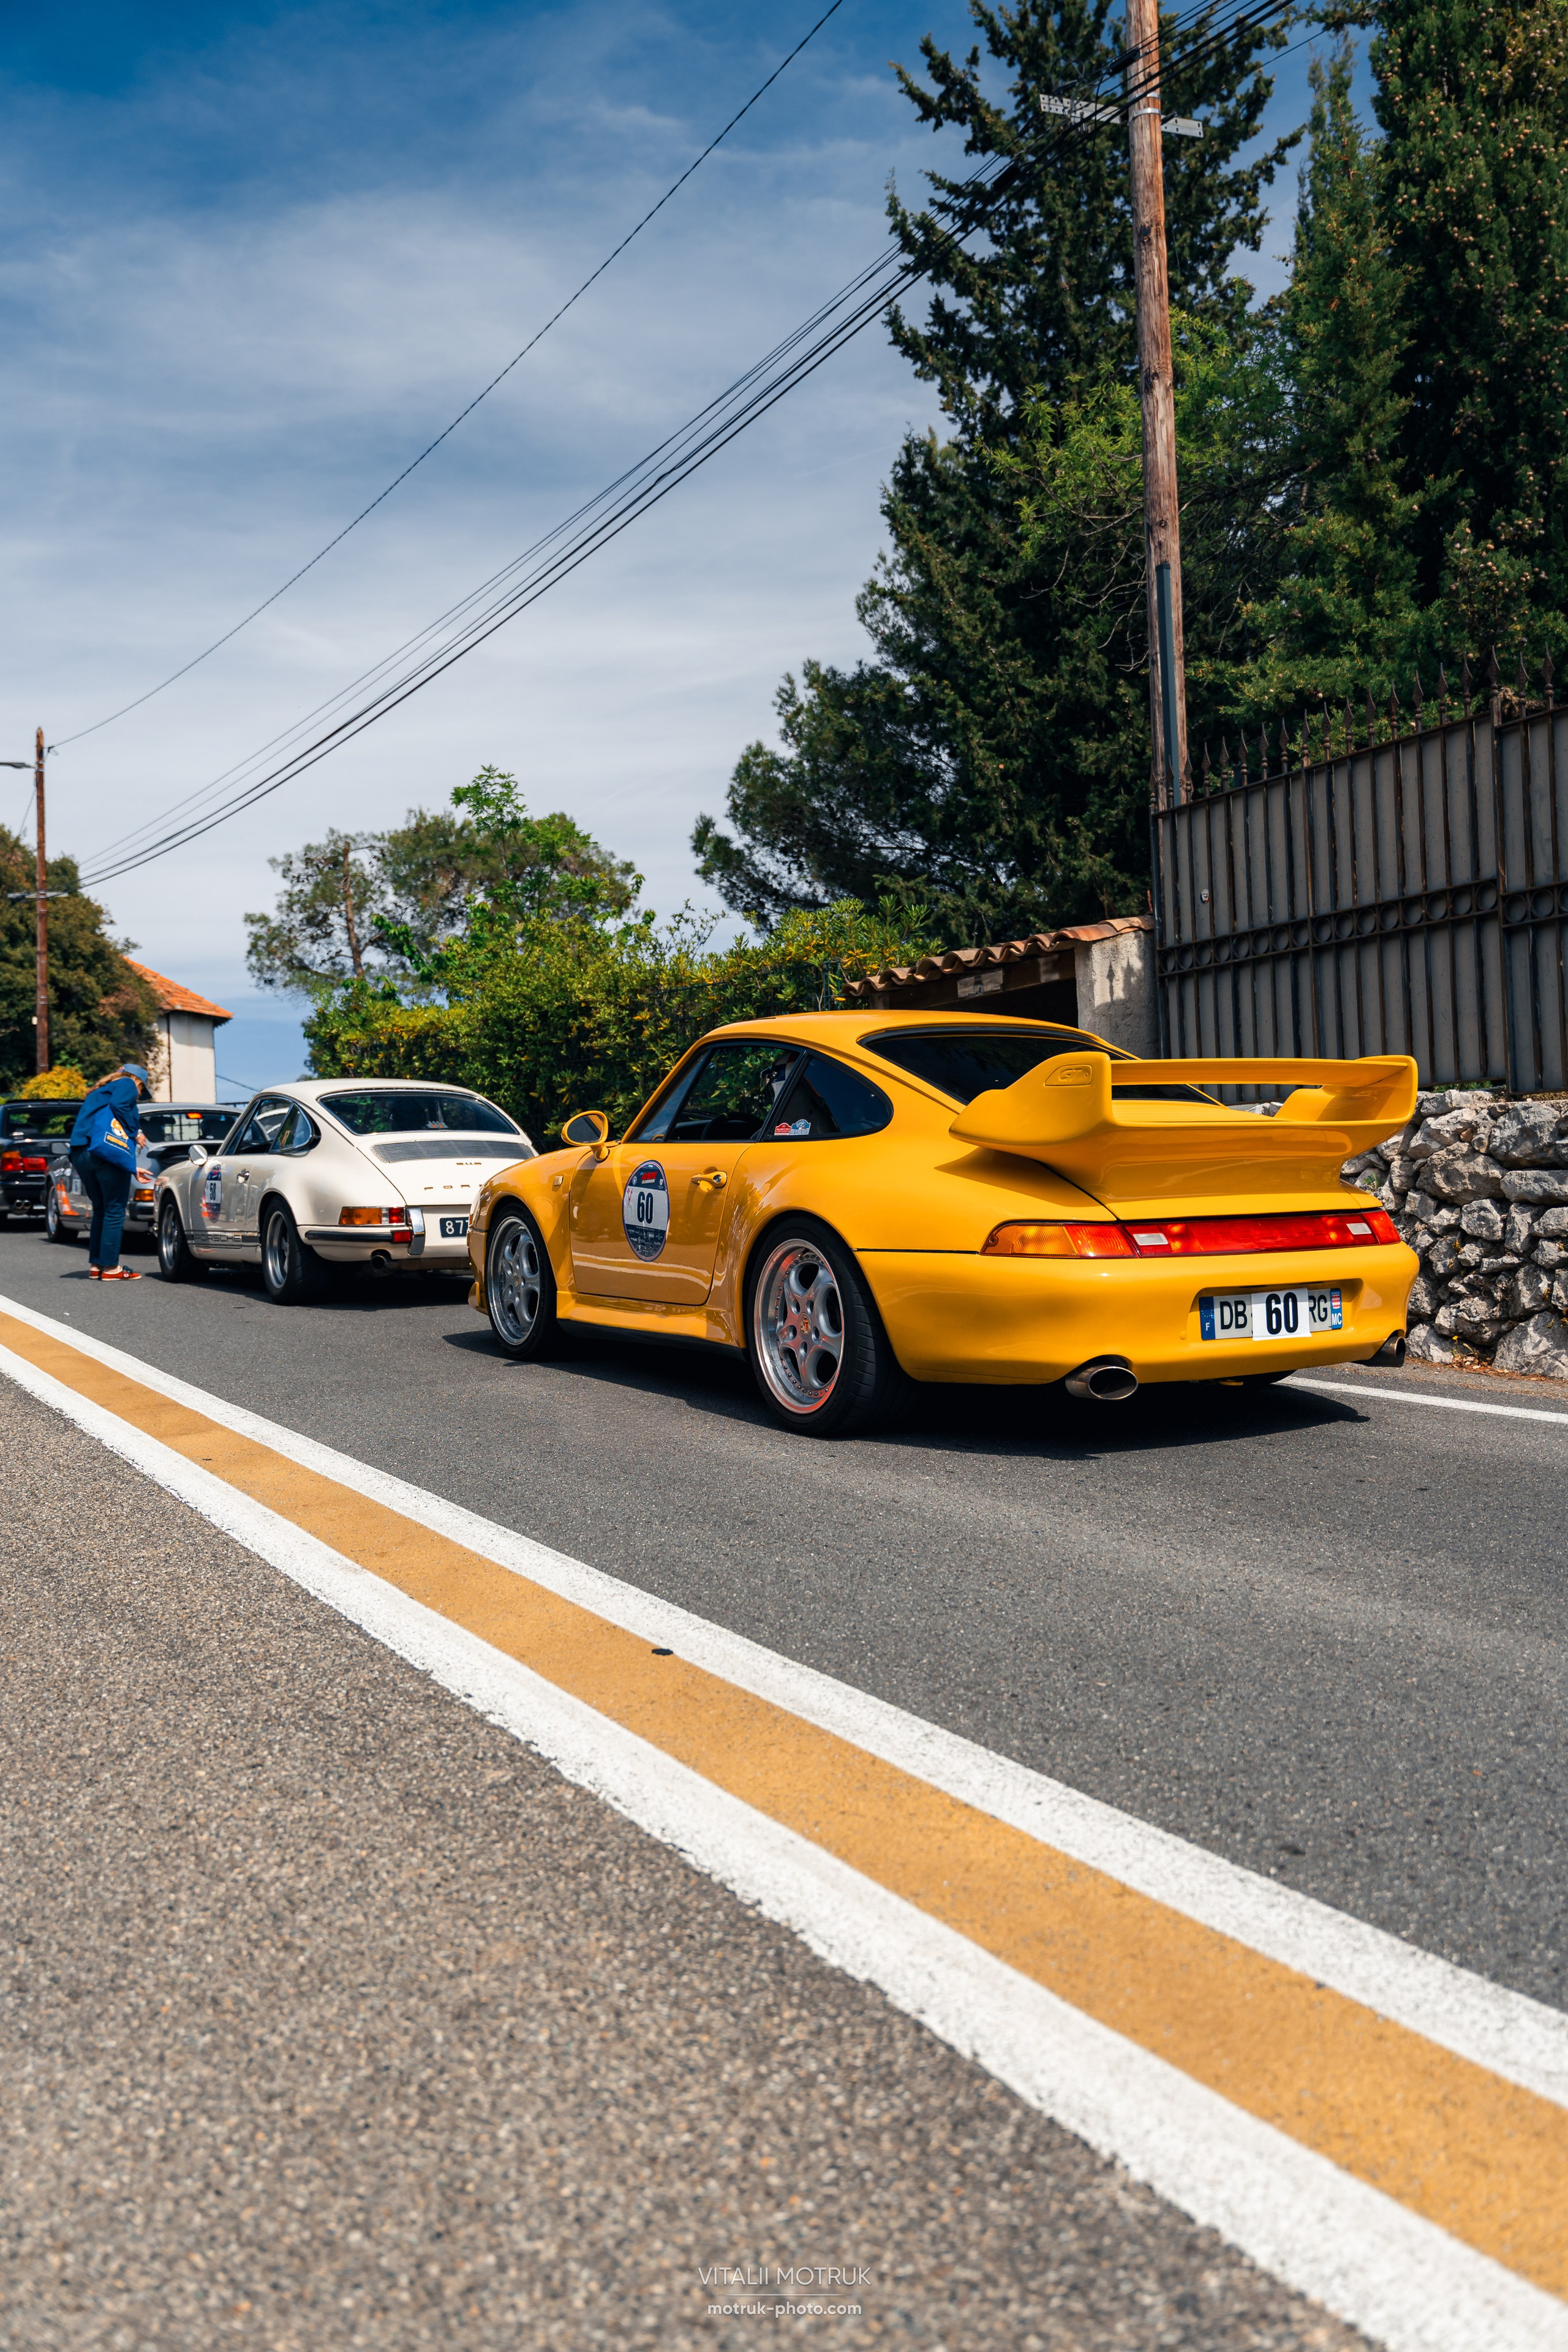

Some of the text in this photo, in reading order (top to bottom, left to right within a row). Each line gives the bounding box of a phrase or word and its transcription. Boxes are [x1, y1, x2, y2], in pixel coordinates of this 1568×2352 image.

[1058, 1068, 1083, 1082] GT
[209, 1182, 217, 1201] 58
[636, 1191, 654, 1224] 60
[445, 1219, 469, 1235] 87
[194, 1234, 242, 1243] PORSCHE
[1219, 1300, 1248, 1330] DB
[1265, 1291, 1299, 1335] 60
[1331, 1312, 1342, 1326] MC
[1205, 1322, 1210, 1331] F
